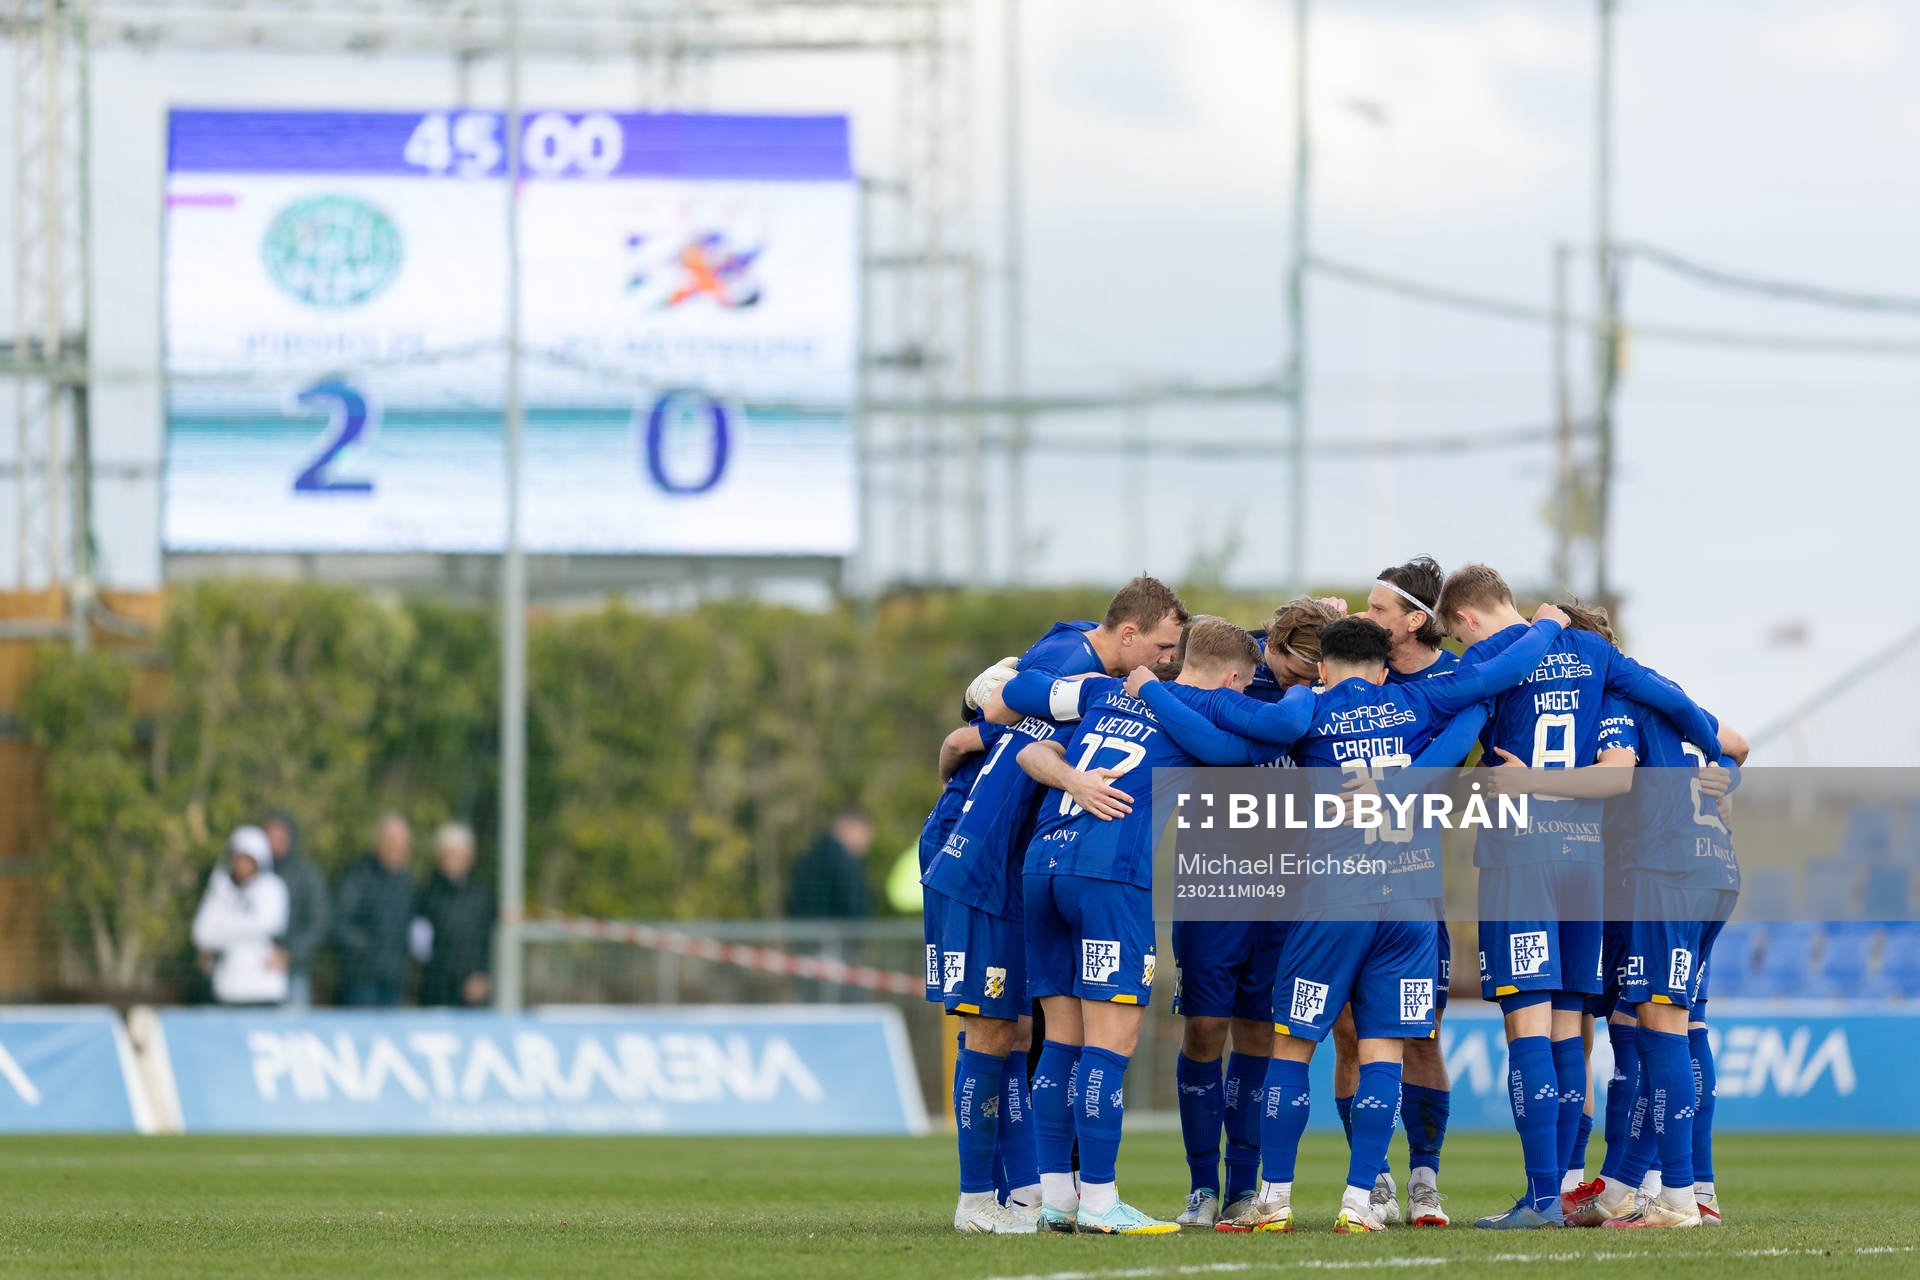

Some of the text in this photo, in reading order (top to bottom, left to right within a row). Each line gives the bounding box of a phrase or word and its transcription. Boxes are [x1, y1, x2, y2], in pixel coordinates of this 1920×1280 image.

[294, 377, 374, 491] 2
[645, 388, 730, 494] 0
[1331, 702, 1397, 721] NORDIC
[1094, 715, 1157, 742] WENDT
[1318, 710, 1416, 735] WELLNESS
[1058, 733, 1146, 816] 17
[1085, 942, 1113, 955] EFF
[1513, 935, 1540, 949] EFF
[1085, 954, 1116, 967] EKT
[1513, 946, 1545, 961] EKT
[1085, 966, 1101, 979] IV
[1514, 959, 1531, 973] IV
[1627, 956, 1644, 975] 21
[1297, 981, 1322, 997] EFF
[1403, 981, 1428, 995] EFF
[1295, 993, 1323, 1010] EKT
[1403, 993, 1431, 1006] EKT
[1293, 1005, 1308, 1018] IV
[1403, 1005, 1419, 1018] IV
[1086, 1068, 1103, 1119] SILFVERLOK
[1512, 1069, 1526, 1118] SILFVERLOK
[960, 1077, 976, 1129] SILFVERLOK
